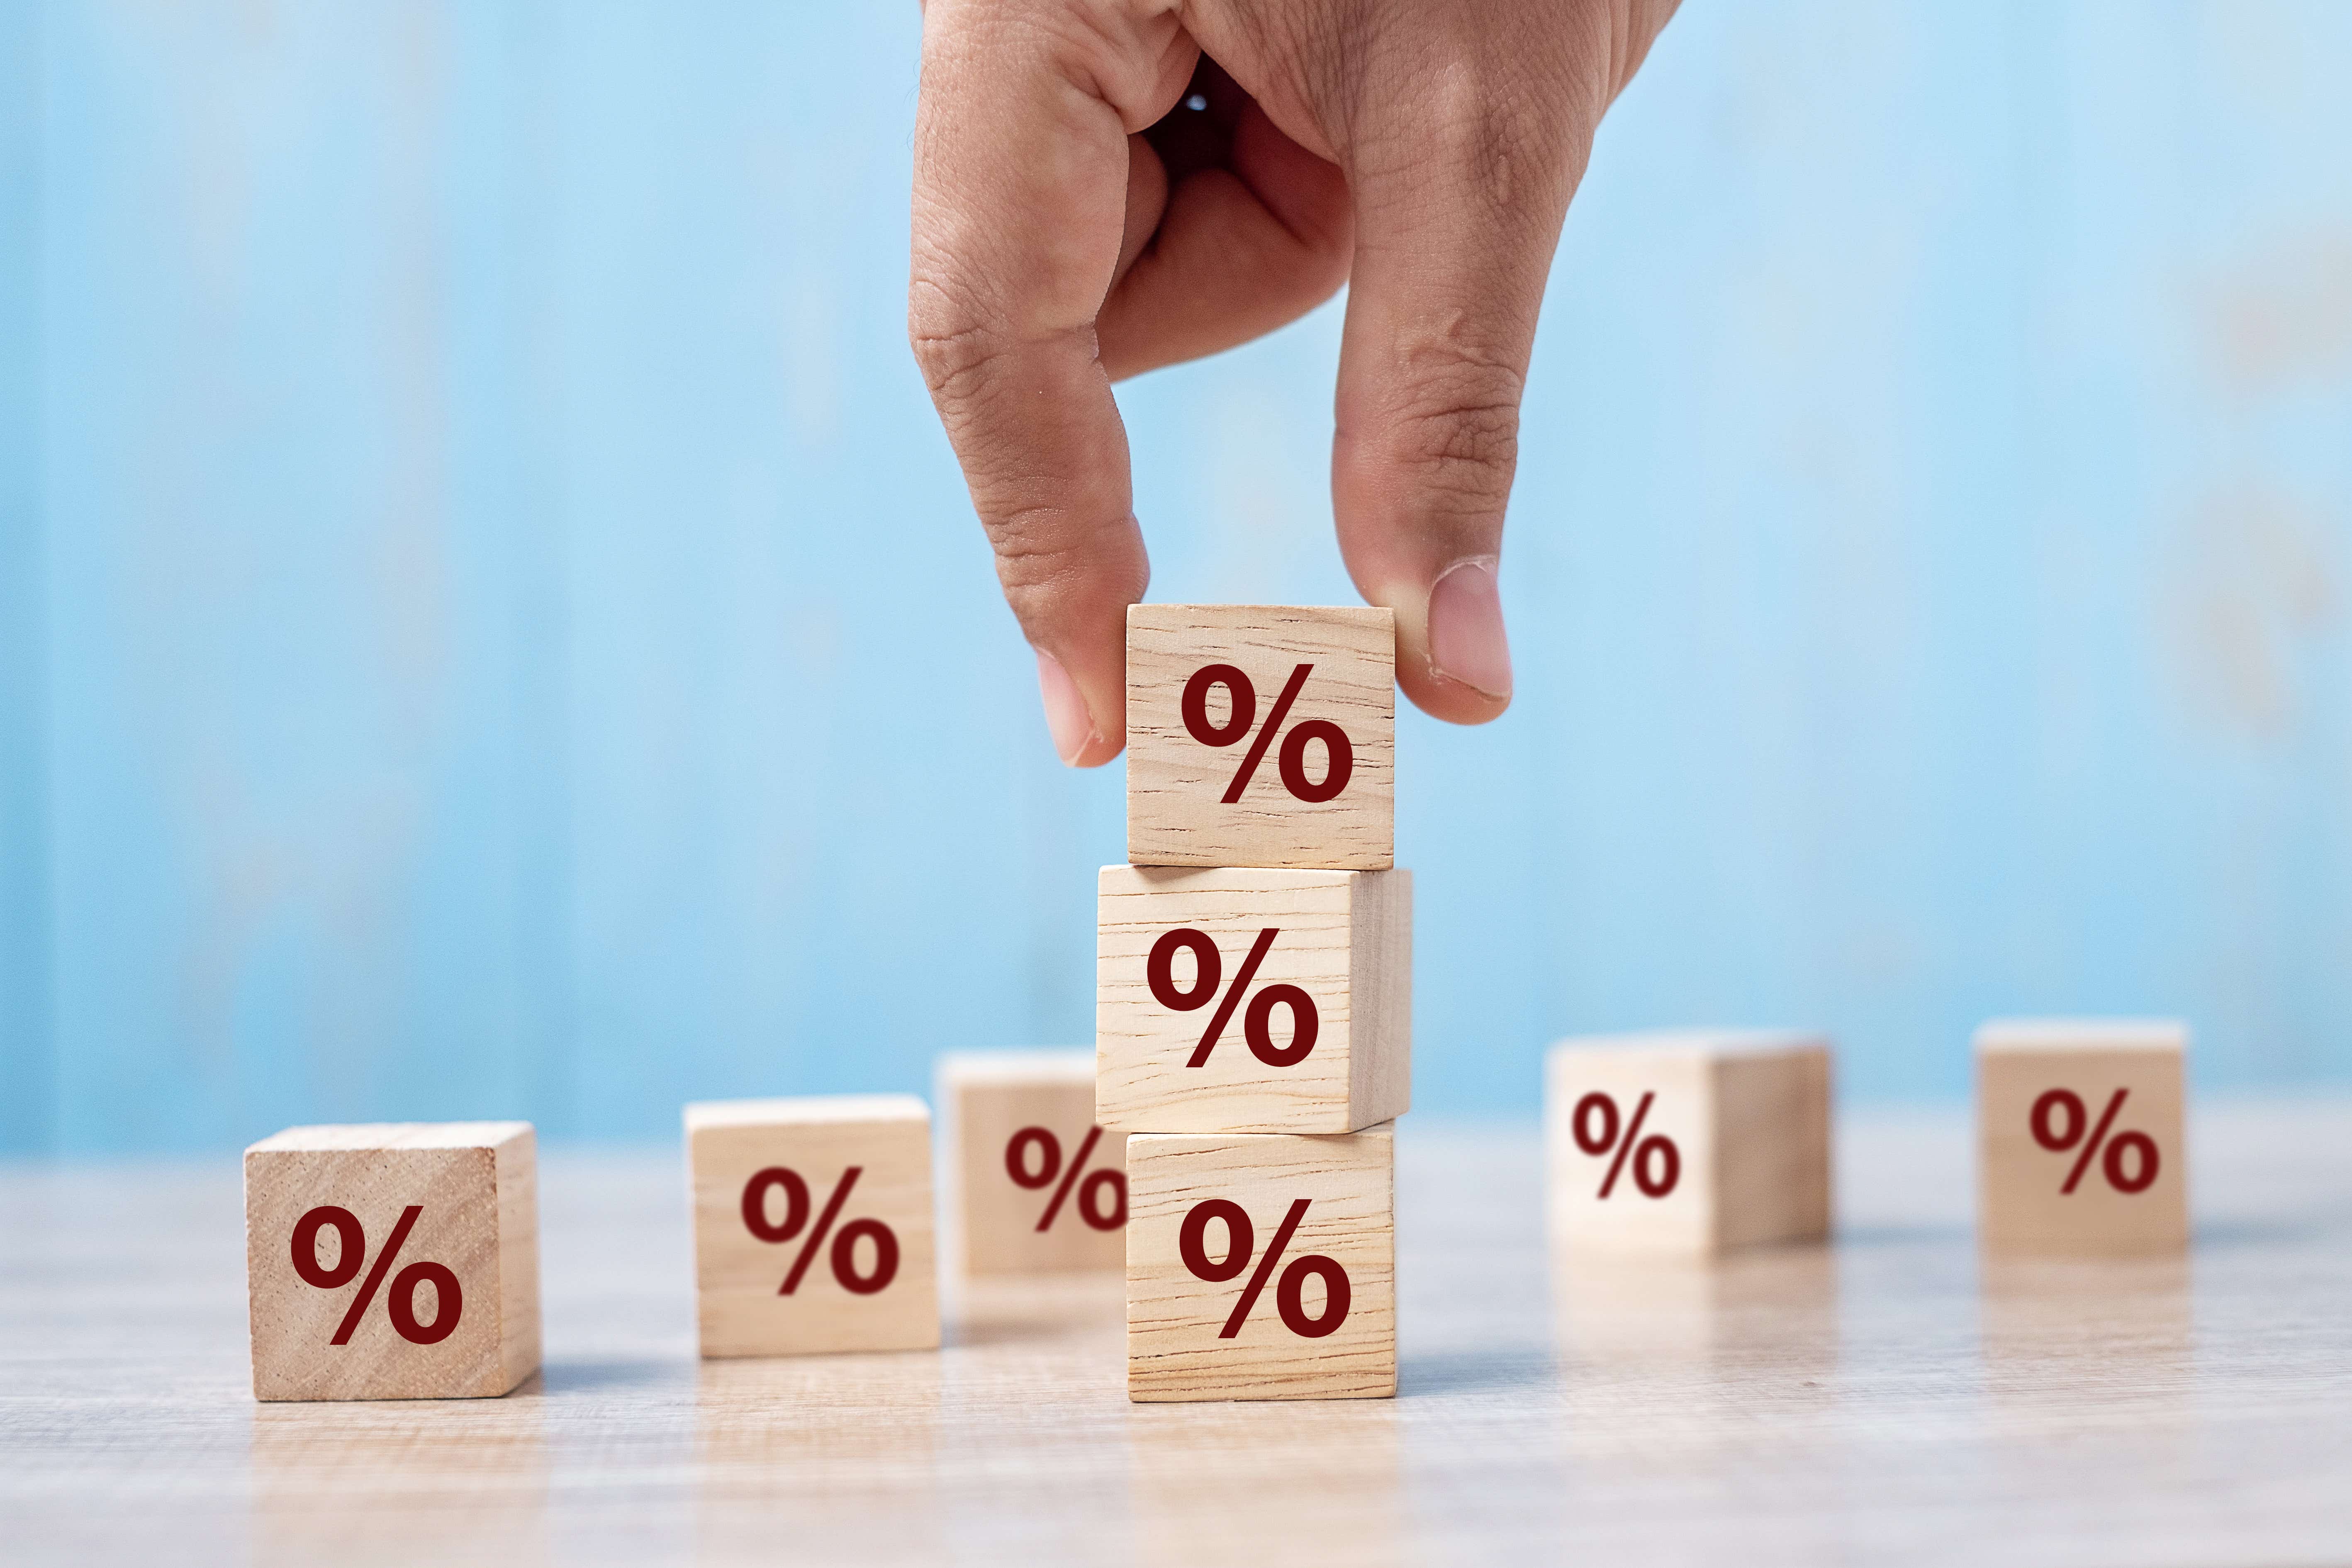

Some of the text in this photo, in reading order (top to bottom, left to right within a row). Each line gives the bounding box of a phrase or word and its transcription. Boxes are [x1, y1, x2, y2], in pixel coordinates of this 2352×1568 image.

[1182, 664, 1354, 803] %
[1147, 928, 1319, 1068] %
[1004, 1125, 1128, 1233] %
[1573, 1092, 1680, 1199] %
[2028, 1088, 2160, 1196] %
[291, 1206, 463, 1345] %
[741, 1167, 900, 1295] %
[1180, 1199, 1351, 1339] %
